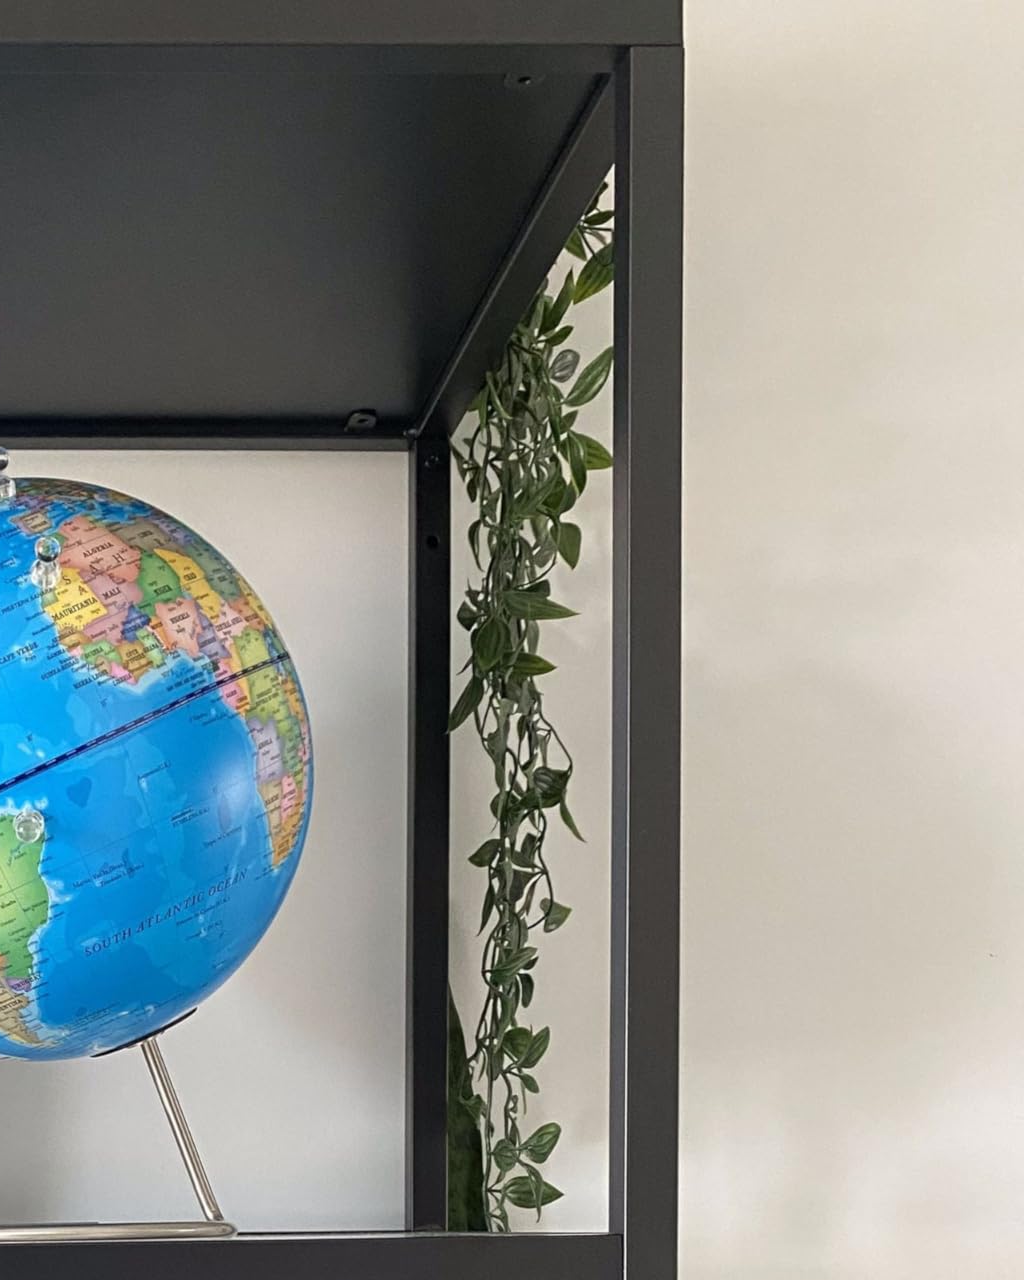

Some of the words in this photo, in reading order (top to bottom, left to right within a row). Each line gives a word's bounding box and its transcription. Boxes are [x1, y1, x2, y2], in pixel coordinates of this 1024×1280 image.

[82, 541, 114, 558] ALGERIA
[102, 587, 121, 600] MALI
[51, 596, 98, 621] MAURITANIA
[84, 927, 132, 957] SOUTH
[136, 892, 204, 934] ATLANTIC
[208, 868, 248, 896] OCEAN
